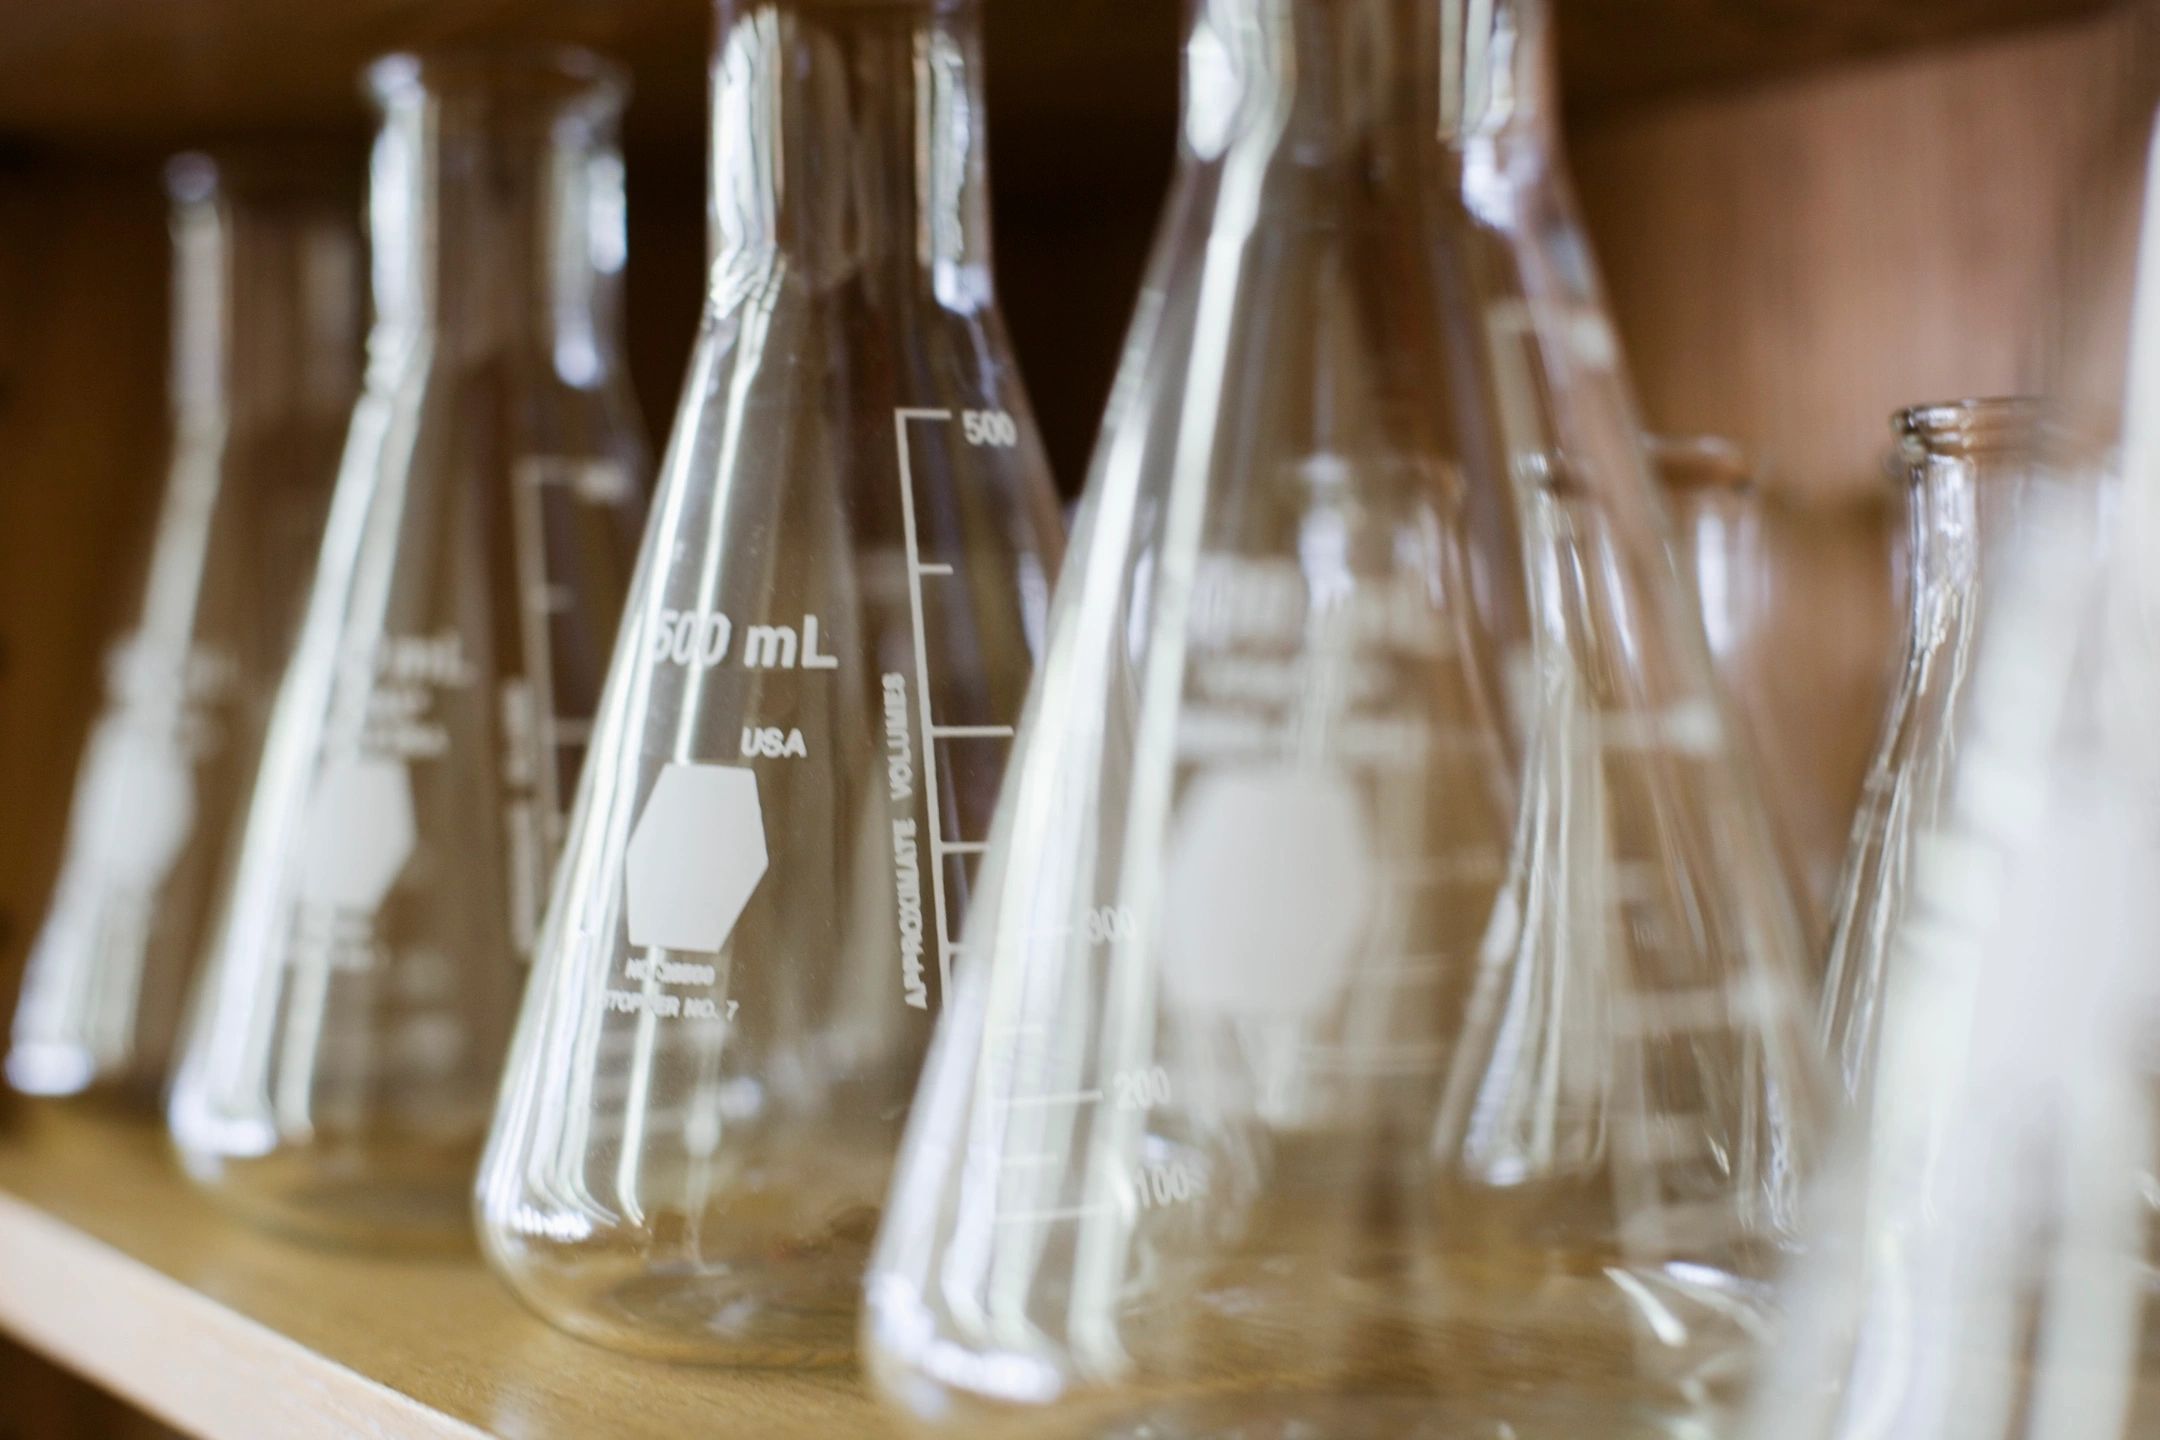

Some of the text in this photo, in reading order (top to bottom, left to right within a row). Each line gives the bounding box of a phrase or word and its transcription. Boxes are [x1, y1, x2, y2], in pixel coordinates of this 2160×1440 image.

[962, 410, 1017, 448] 500
[652, 610, 838, 670] 500 mL
[741, 726, 807, 758] USA
[881, 671, 928, 1011] APPROXIMATE VOLUMES
[726, 999, 740, 1022] 7
[1112, 1065, 1172, 1112] 200
